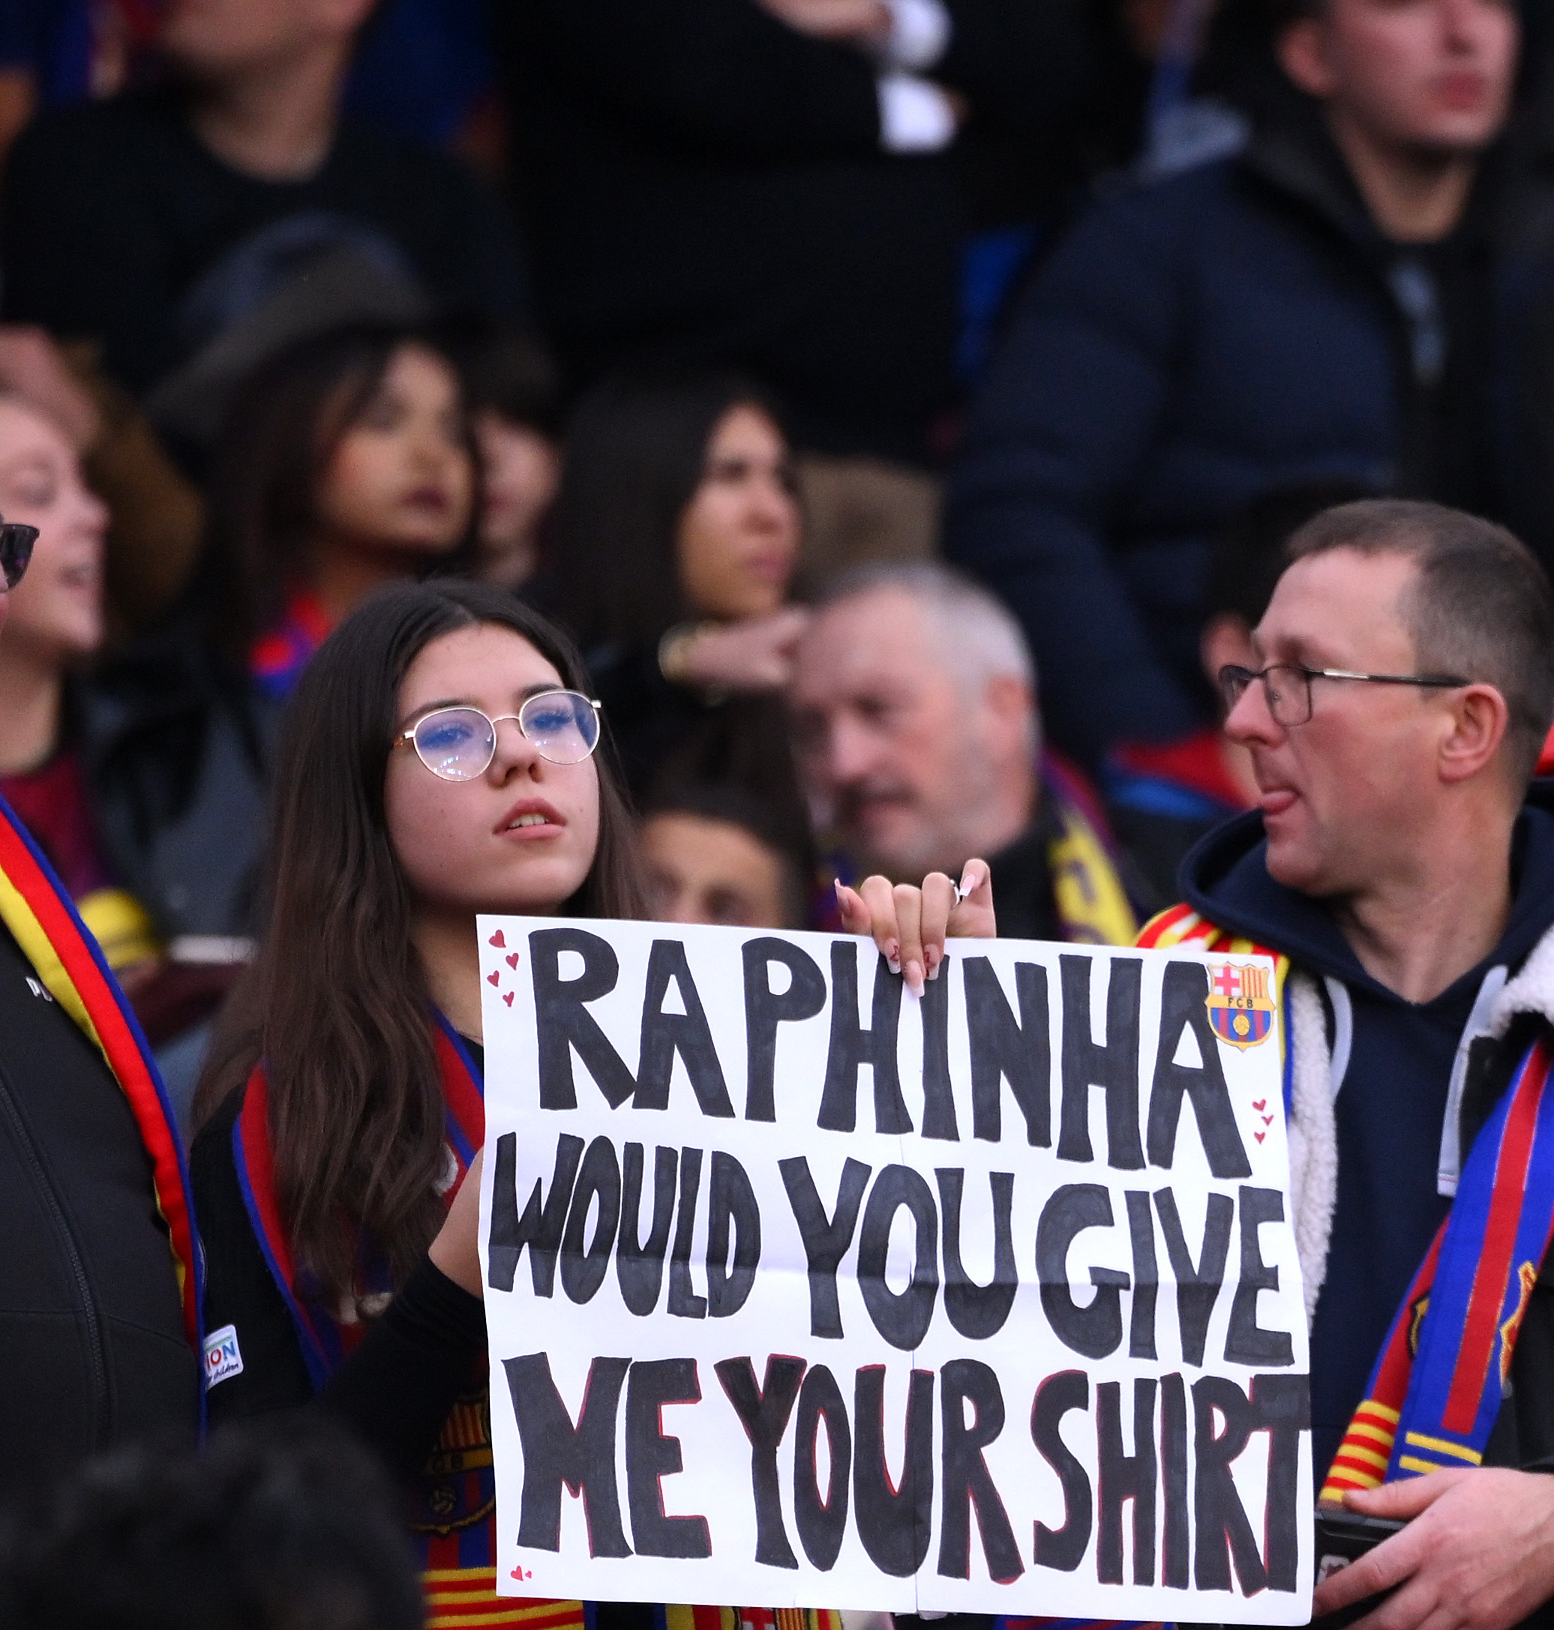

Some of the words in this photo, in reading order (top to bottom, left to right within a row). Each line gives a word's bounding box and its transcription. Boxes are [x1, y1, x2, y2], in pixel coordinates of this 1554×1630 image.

[528, 926, 1252, 1179] RAPHINHA
[1227, 997, 1254, 1009] FCB
[487, 1131, 761, 1319] WOULD
[778, 1154, 1019, 1352] YOU
[1035, 1183, 1295, 1367] GIVE
[500, 1351, 713, 1559] ME
[714, 1352, 1026, 1585] YOUR
[1030, 1369, 1312, 1599] SHIRT
